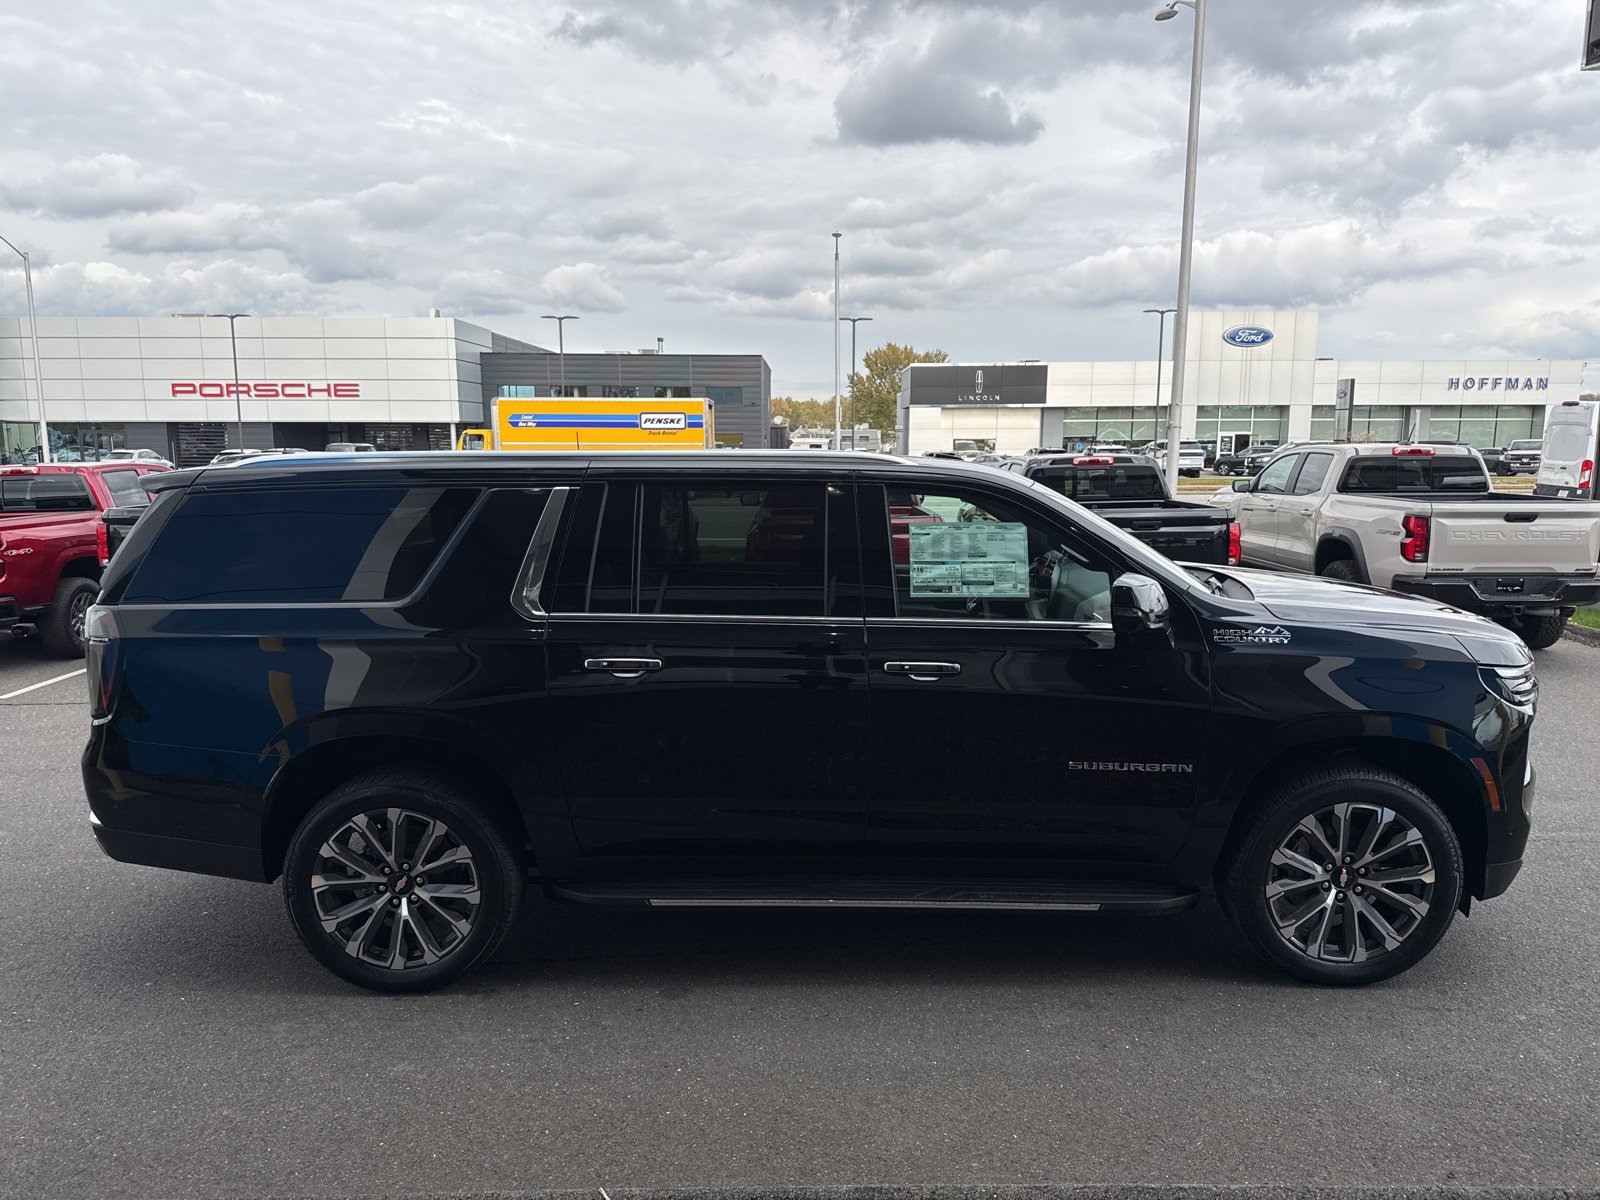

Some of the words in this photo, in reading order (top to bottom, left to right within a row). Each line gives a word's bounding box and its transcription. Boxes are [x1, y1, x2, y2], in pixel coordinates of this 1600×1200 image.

[1235, 329, 1265, 342] Ford
[1447, 377, 1549, 391] HOFFMAN
[171, 383, 360, 398] PORSCHE
[643, 417, 683, 425] PENSKE
[1450, 530, 1588, 541] CHEVROLET
[1213, 636, 1291, 644] COUNTRY
[1068, 761, 1193, 772] SUBURBAN
